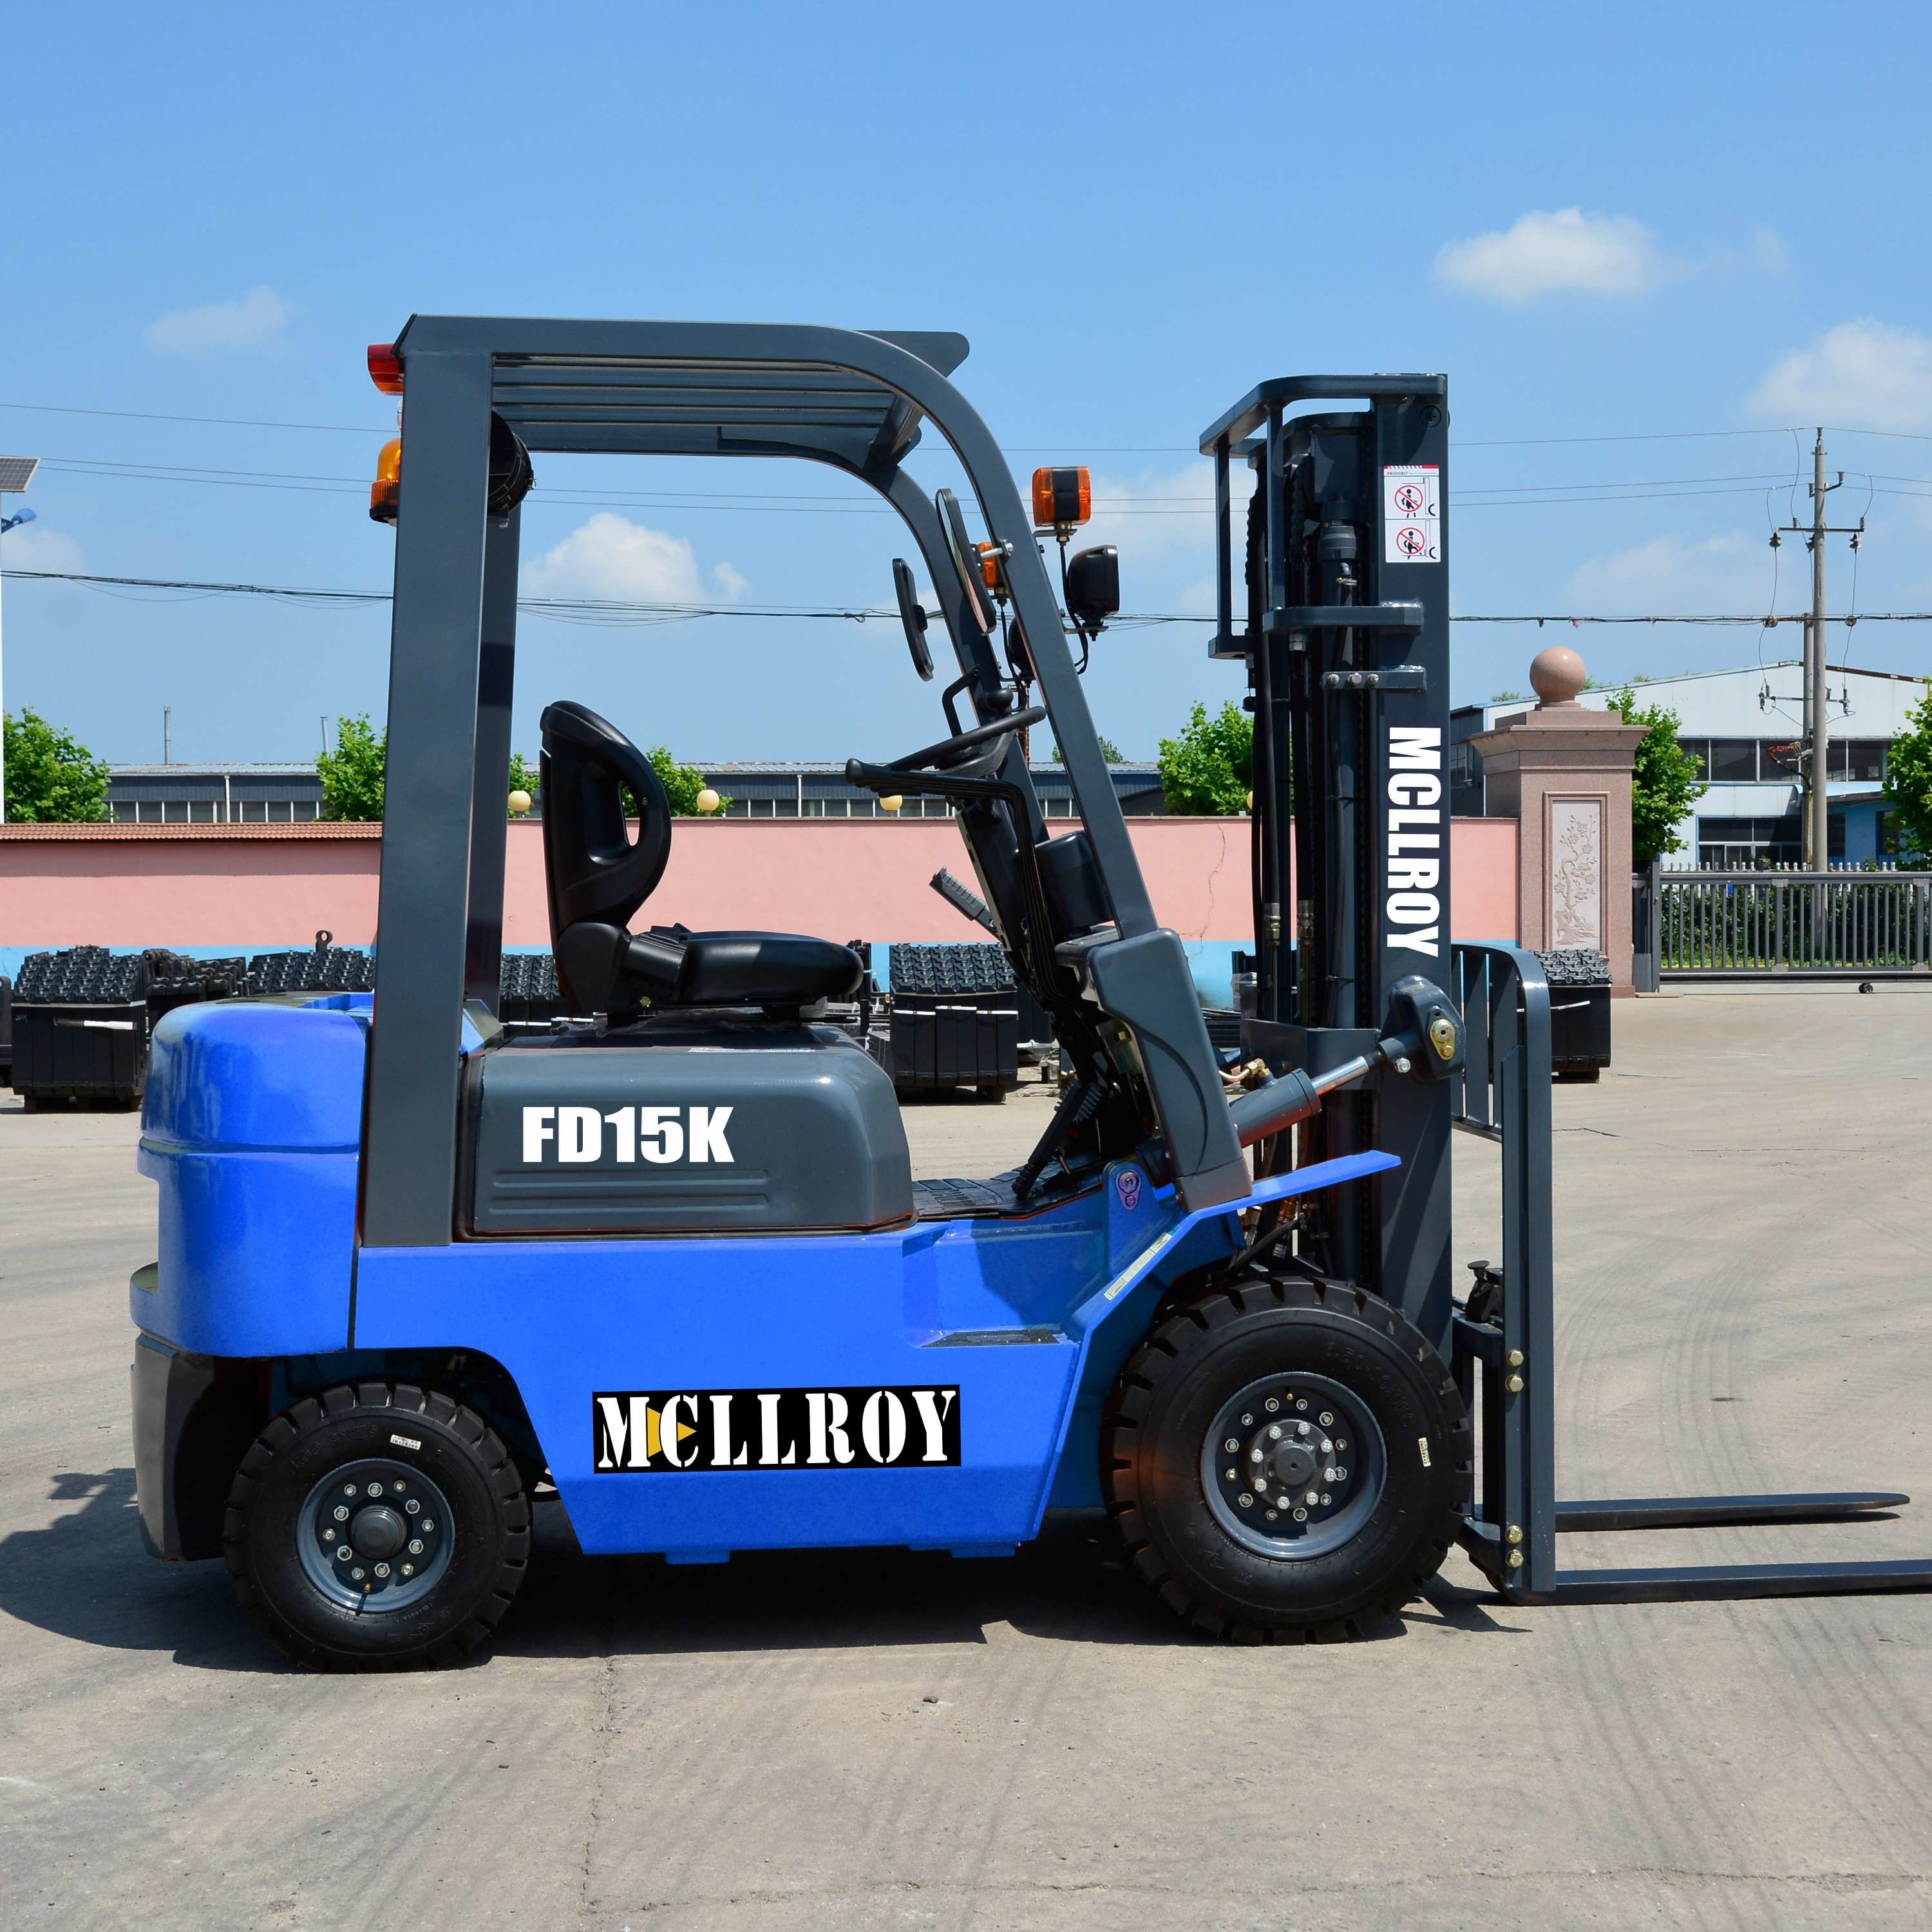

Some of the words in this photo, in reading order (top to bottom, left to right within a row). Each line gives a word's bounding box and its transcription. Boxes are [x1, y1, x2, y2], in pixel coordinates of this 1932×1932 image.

[1386, 727, 1441, 958] MCLLROY
[523, 1106, 735, 1164] FD15K
[596, 1390, 956, 1468] MCLLROY
